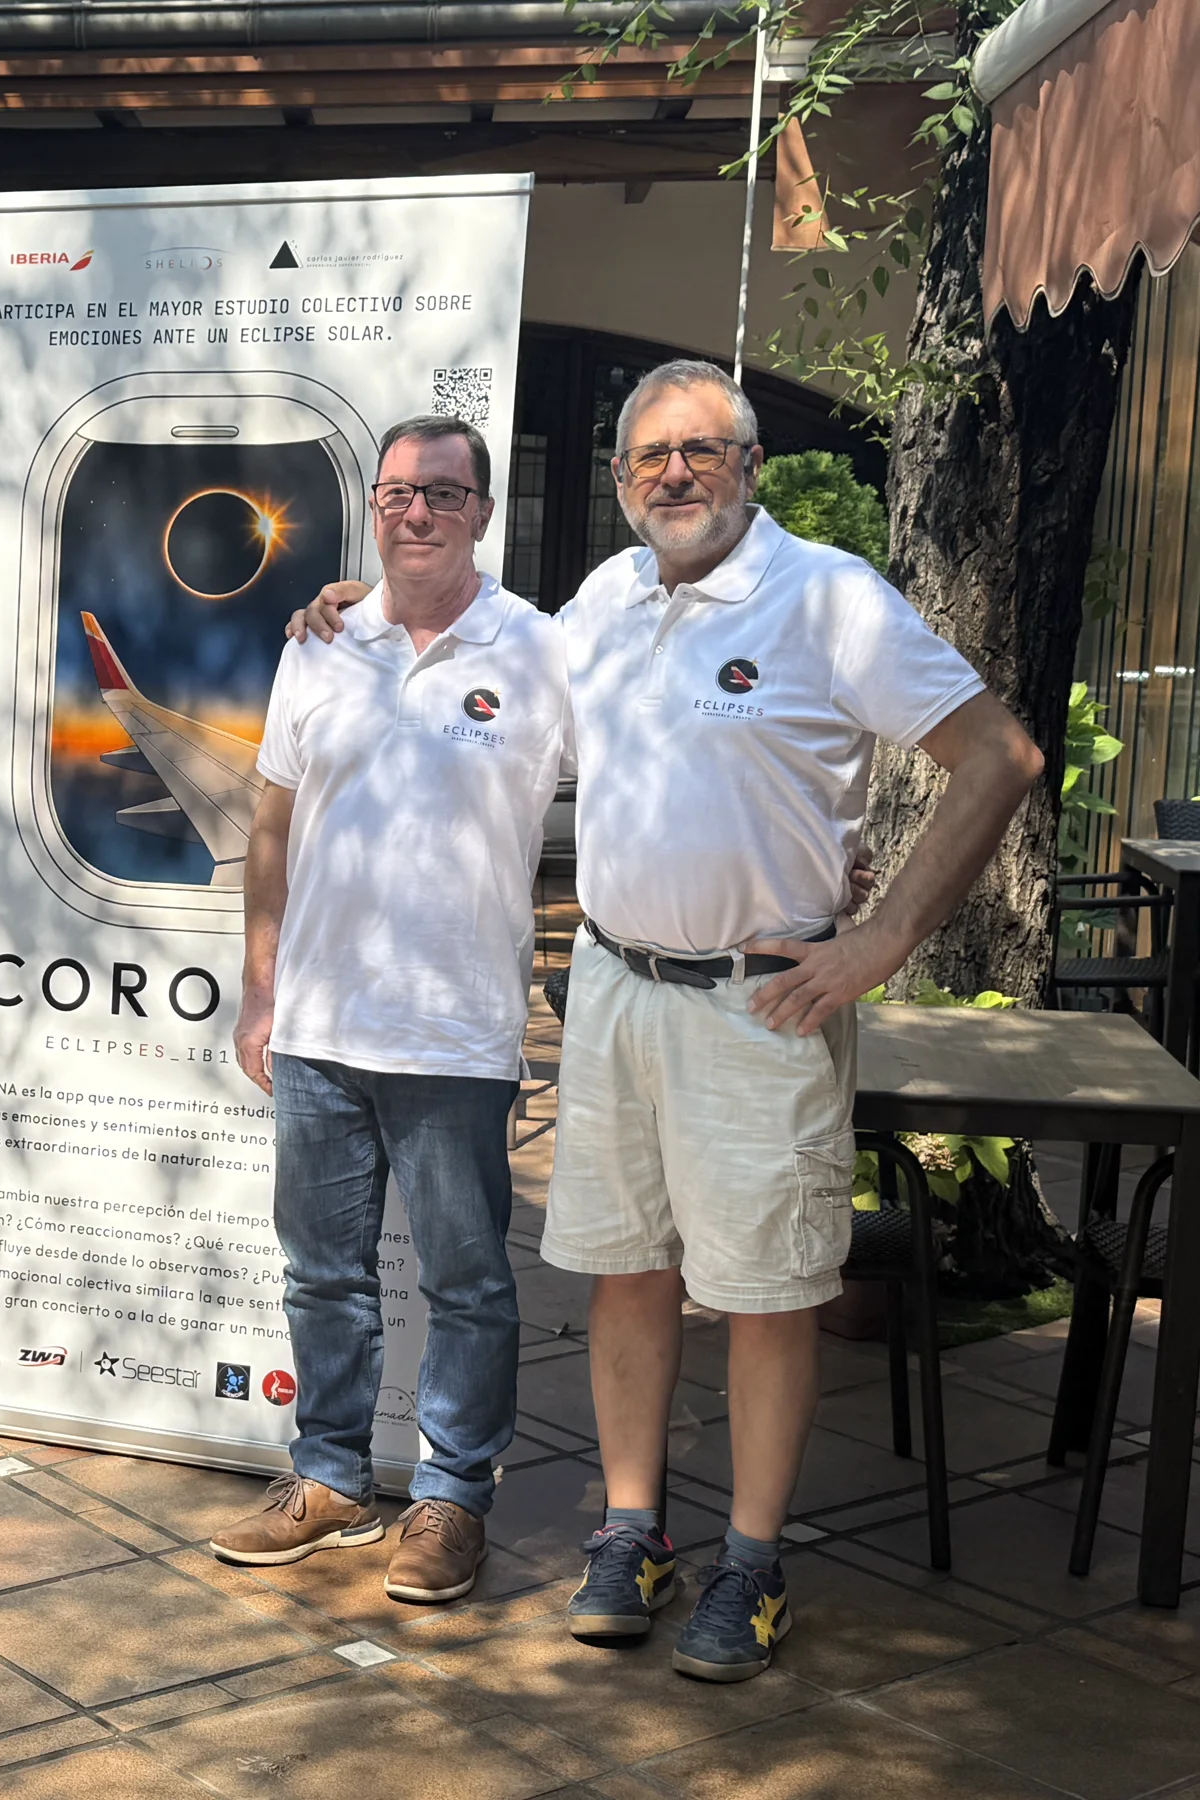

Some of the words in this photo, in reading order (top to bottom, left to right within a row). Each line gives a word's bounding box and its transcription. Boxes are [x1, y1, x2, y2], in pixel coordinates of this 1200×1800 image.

[10, 252, 70, 265] IBERIA
[334, 255, 360, 263] javier
[87, 302, 107, 318] EN
[118, 302, 138, 317] EL
[149, 300, 203, 317] MAYOR
[215, 298, 290, 316] ESTUDIO
[301, 296, 403, 314] COLECTIVO
[415, 294, 472, 312] SOBRE
[49, 329, 142, 346] EMOCIONES
[153, 328, 195, 344] ANTE
[208, 327, 228, 344] UN
[240, 325, 316, 343] ECLIPSE
[327, 325, 393, 342] SOLAR.
[693, 699, 765, 717] ECLIPSES
[442, 724, 506, 746] ECLIPSES
[45, 1035, 229, 1064] ECLIPSES_IB1
[21, 1086, 36, 1098] es
[39, 1085, 52, 1100] la
[56, 1089, 84, 1106] app
[88, 1092, 114, 1108] que
[118, 1094, 144, 1108] nos
[148, 1097, 219, 1115] permitirá
[11, 1111, 86, 1130] emociones
[90, 1119, 99, 1133] y
[103, 1119, 197, 1141] sentimientos
[201, 1129, 236, 1143] ante
[240, 1134, 268, 1146] uno
[4, 1136, 117, 1161] extraordinarios
[121, 1147, 140, 1162] de
[143, 1149, 157, 1163] la
[161, 1152, 247, 1171] naturaleza:
[252, 1163, 270, 1173] un
[44, 1193, 99, 1211] nuestra
[103, 1200, 186, 1220] percepción
[189, 1207, 212, 1222] del
[216, 1210, 276, 1229] tiempo
[16, 1216, 66, 1234] ¿Cómo
[70, 1223, 181, 1247] reaccionamos?
[184, 1235, 224, 1252] ¿Qué
[35, 1244, 78, 1262] desde
[82, 1250, 127, 1268] donde
[131, 1255, 144, 1269] lo
[149, 1257, 249, 1281] observamos?
[65, 1274, 132, 1294] colectiva
[198, 1289, 212, 1304] la
[216, 1295, 244, 1308] que
[4, 1294, 38, 1309] gran
[41, 1299, 110, 1318] concierto
[114, 1309, 124, 1320] o
[127, 1311, 137, 1321] a
[140, 1310, 154, 1324] la
[158, 1312, 176, 1326] de
[180, 1316, 225, 1333] ganar
[230, 1323, 247, 1335] un
[387, 1316, 406, 1328] un
[121, 1357, 202, 1389] Seestar
